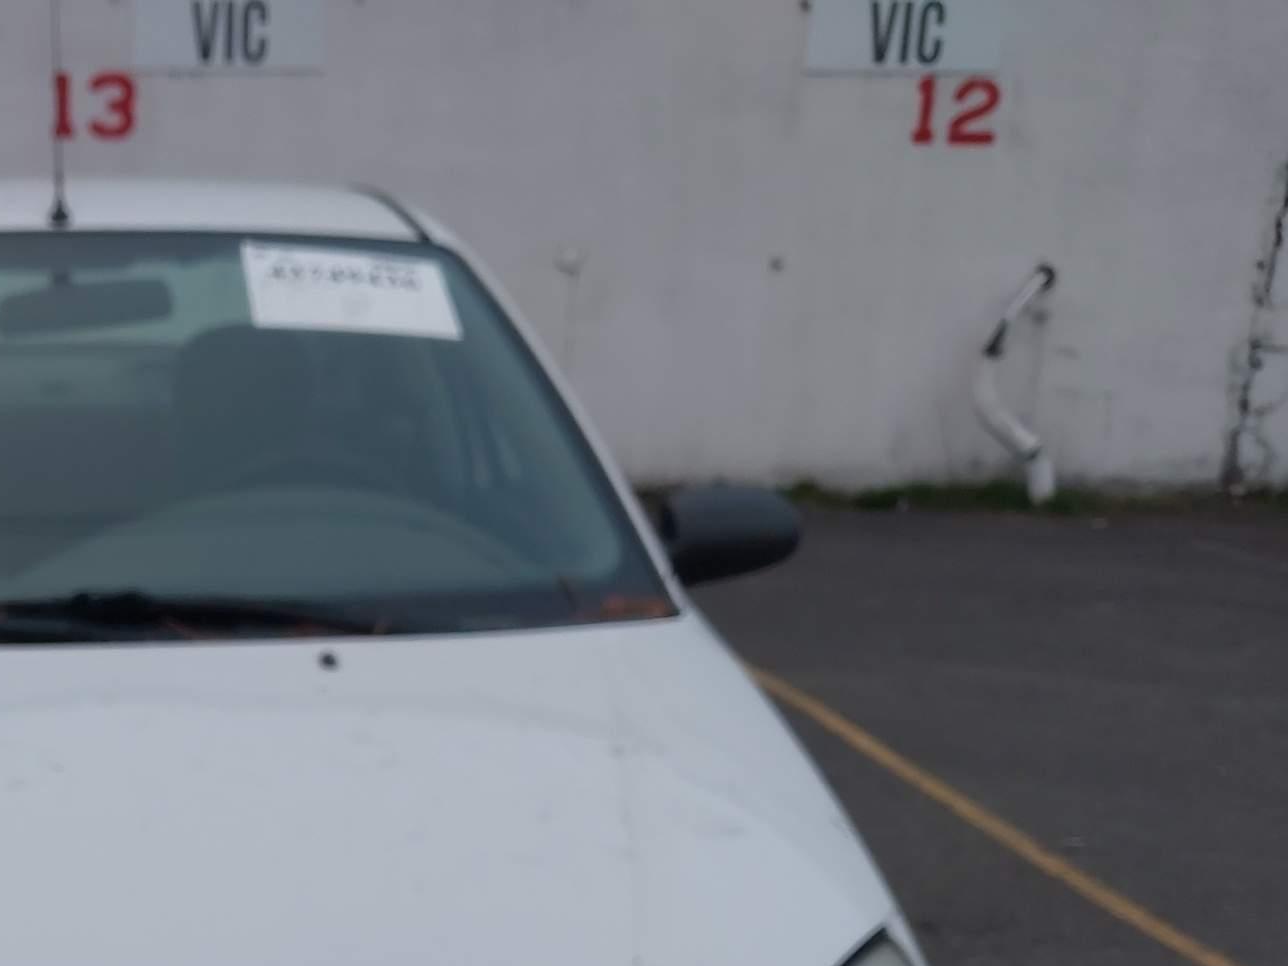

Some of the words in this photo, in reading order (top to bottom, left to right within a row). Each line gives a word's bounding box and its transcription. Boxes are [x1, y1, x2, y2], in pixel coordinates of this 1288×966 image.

[192, 0, 269, 63] VIC
[871, 1, 944, 63] VIC
[53, 71, 136, 139] 13
[911, 75, 1000, 144] 12
